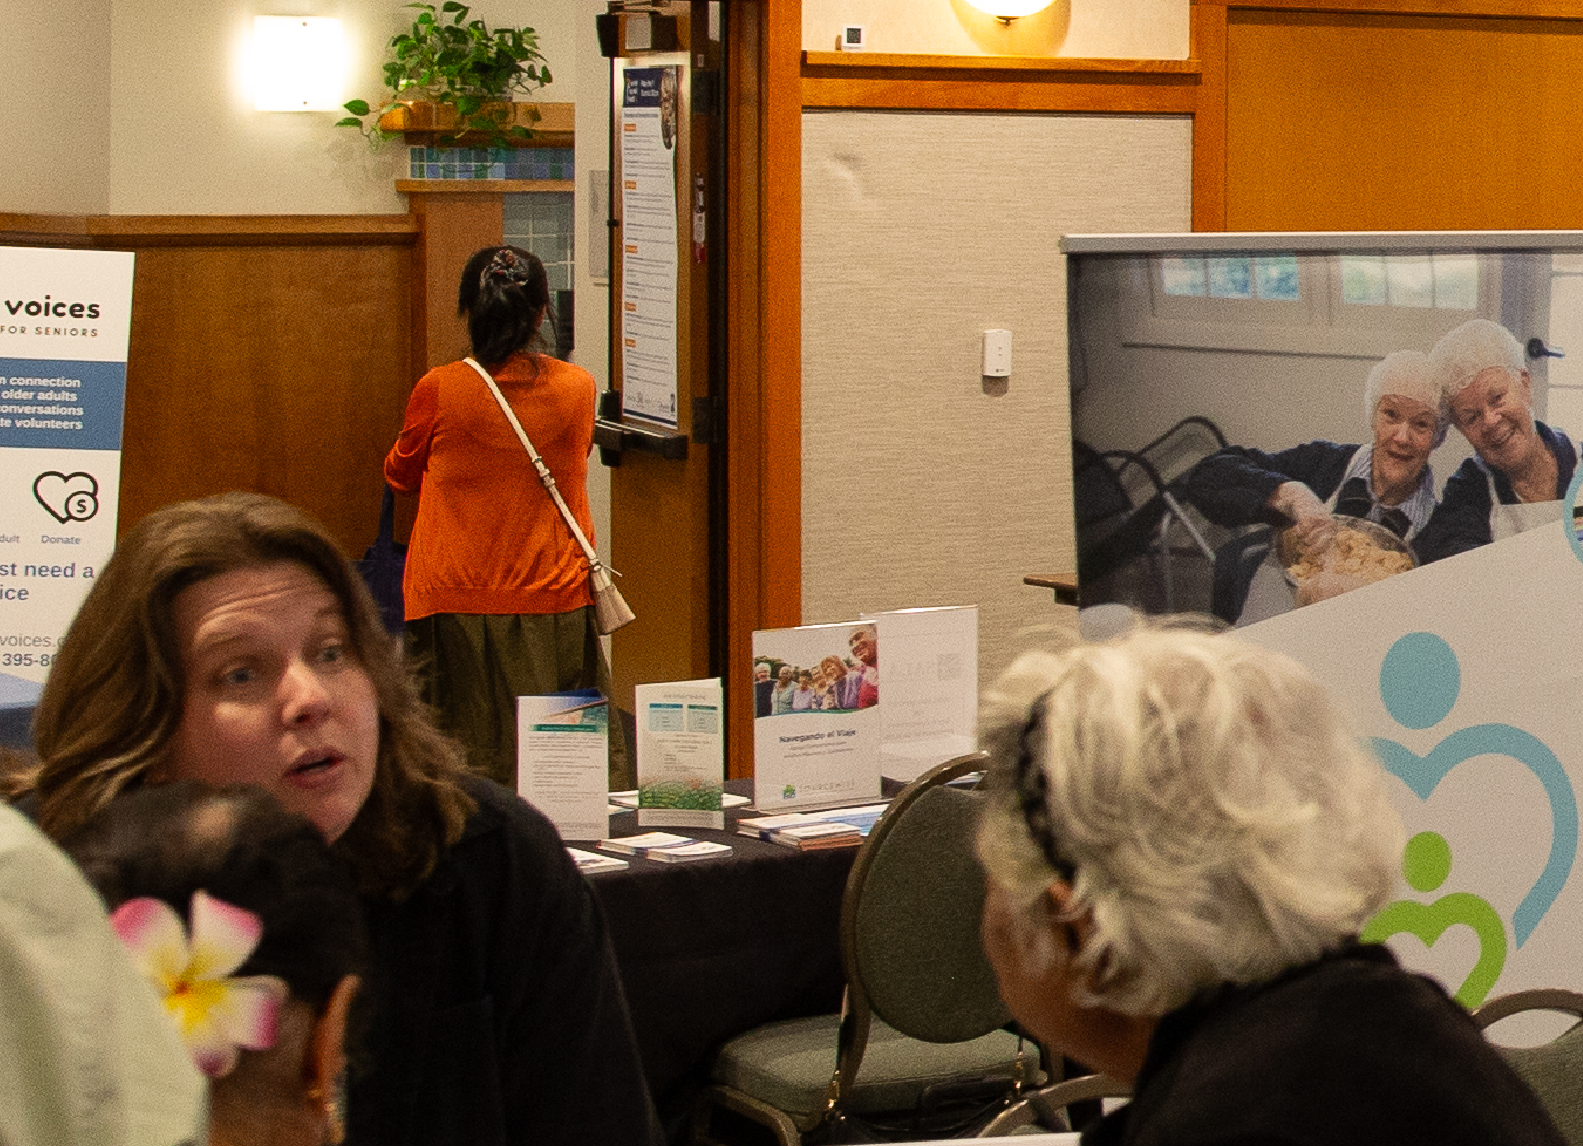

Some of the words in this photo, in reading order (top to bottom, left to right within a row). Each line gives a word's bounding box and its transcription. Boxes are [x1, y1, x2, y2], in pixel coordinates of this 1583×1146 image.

[4, 295, 100, 319] voices
[35, 326, 98, 337] SENIORS
[10, 376, 80, 388] connection
[2, 390, 34, 399] older
[37, 392, 78, 402] adults
[0, 404, 84, 416] onversations
[15, 418, 84, 430] volunteers
[0, 535, 20, 544] dult
[41, 535, 80, 545] Donate
[0, 563, 17, 577] st
[24, 563, 76, 578] need
[83, 566, 94, 578] a
[0, 585, 30, 601] ice
[0, 635, 62, 648] voices.
